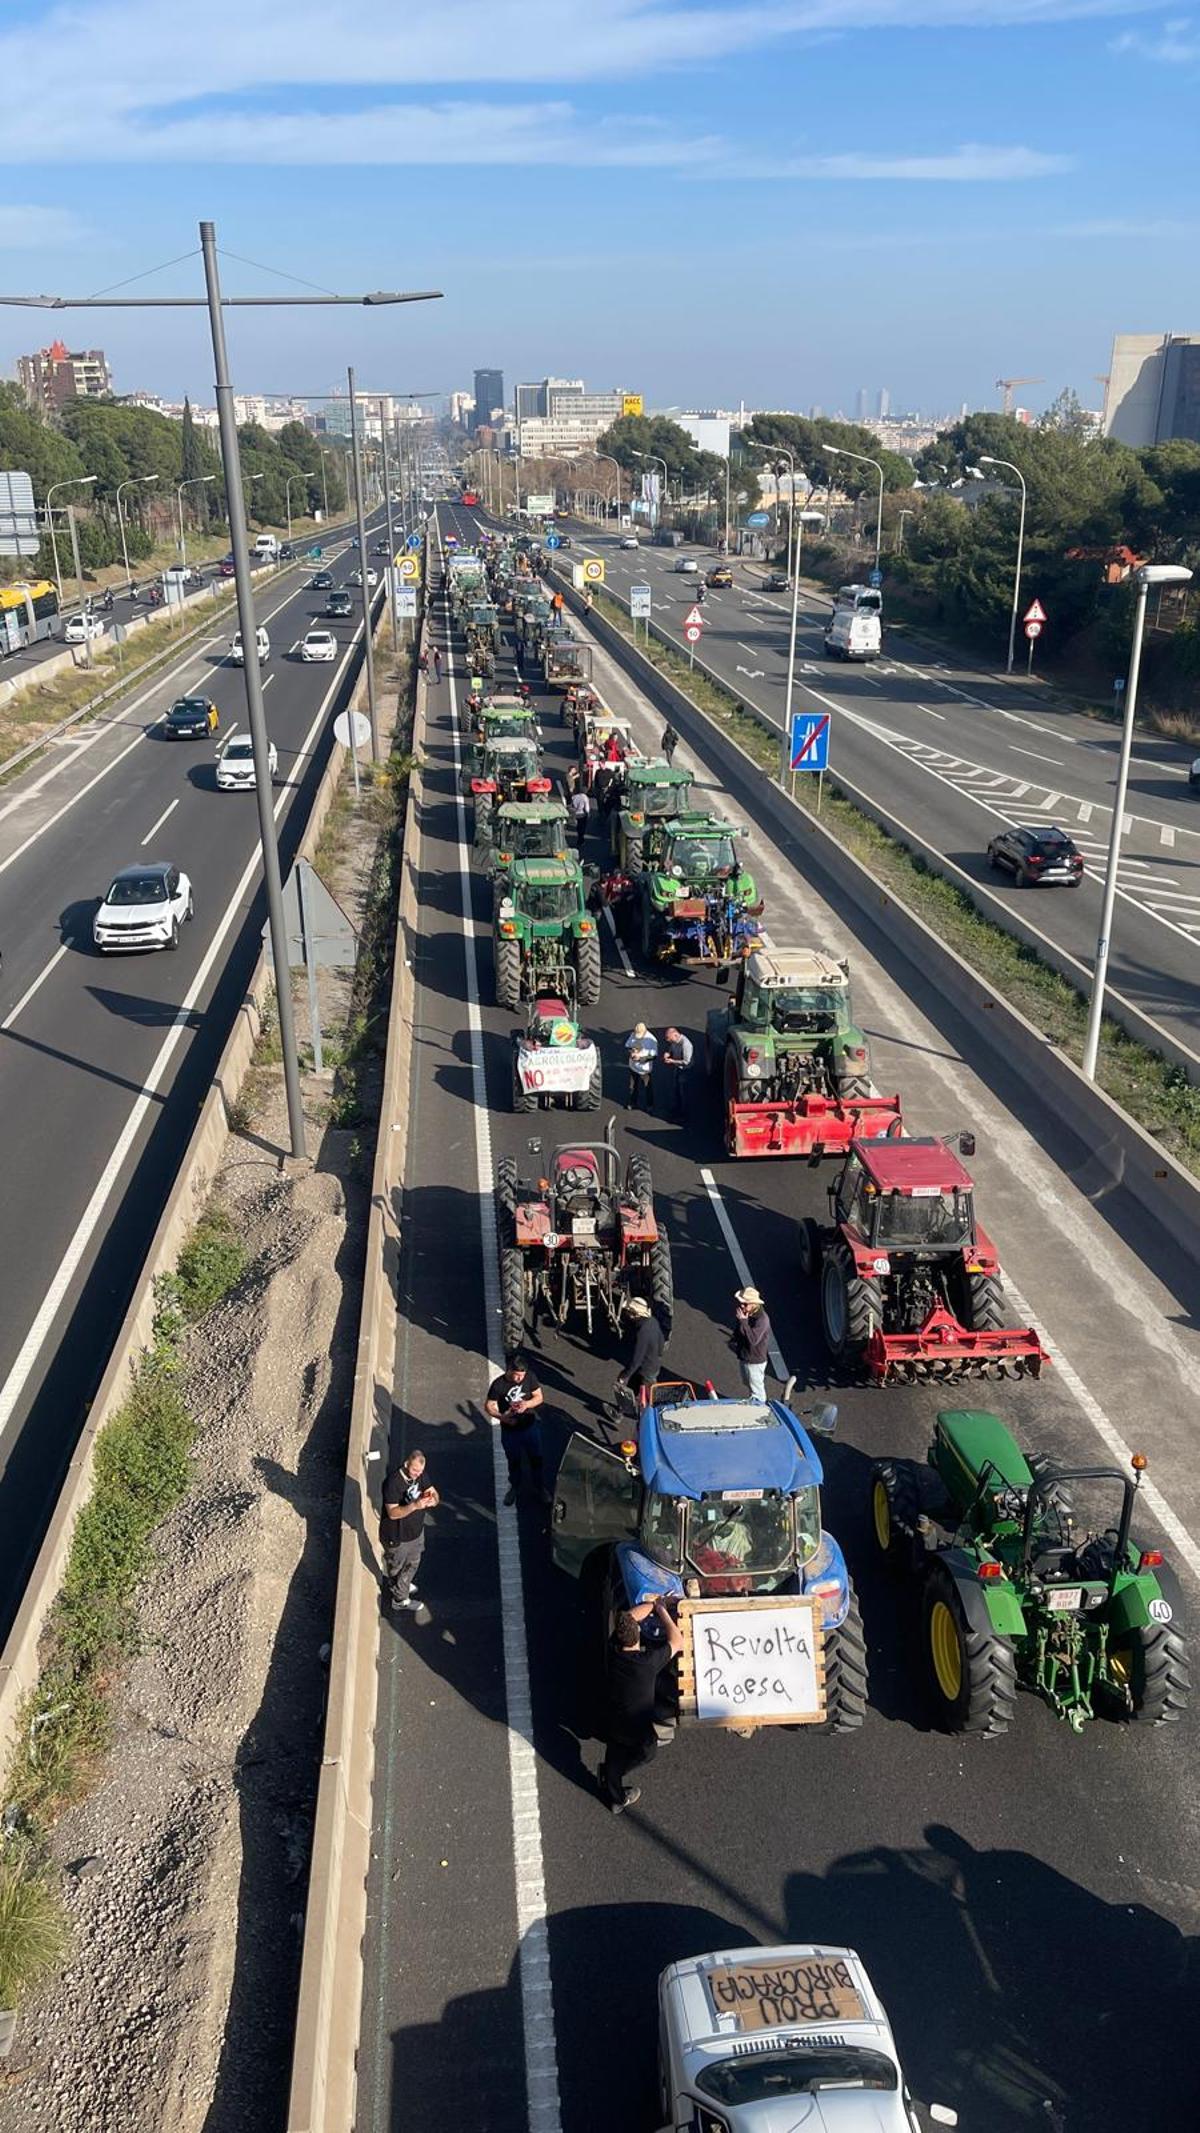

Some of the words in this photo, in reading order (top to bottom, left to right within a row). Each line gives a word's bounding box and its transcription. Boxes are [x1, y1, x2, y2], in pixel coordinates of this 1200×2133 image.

[523, 1069, 545, 1089] NO
[546, 1234, 558, 1245] 30
[876, 1260, 888, 1271] 40
[1153, 1602, 1170, 1619] 40
[704, 1626, 811, 1661] Revolta
[704, 1667, 792, 1704] Pagesa
[707, 1961, 855, 2011] BUROCRACIA!
[759, 1990, 840, 2024] PROU
